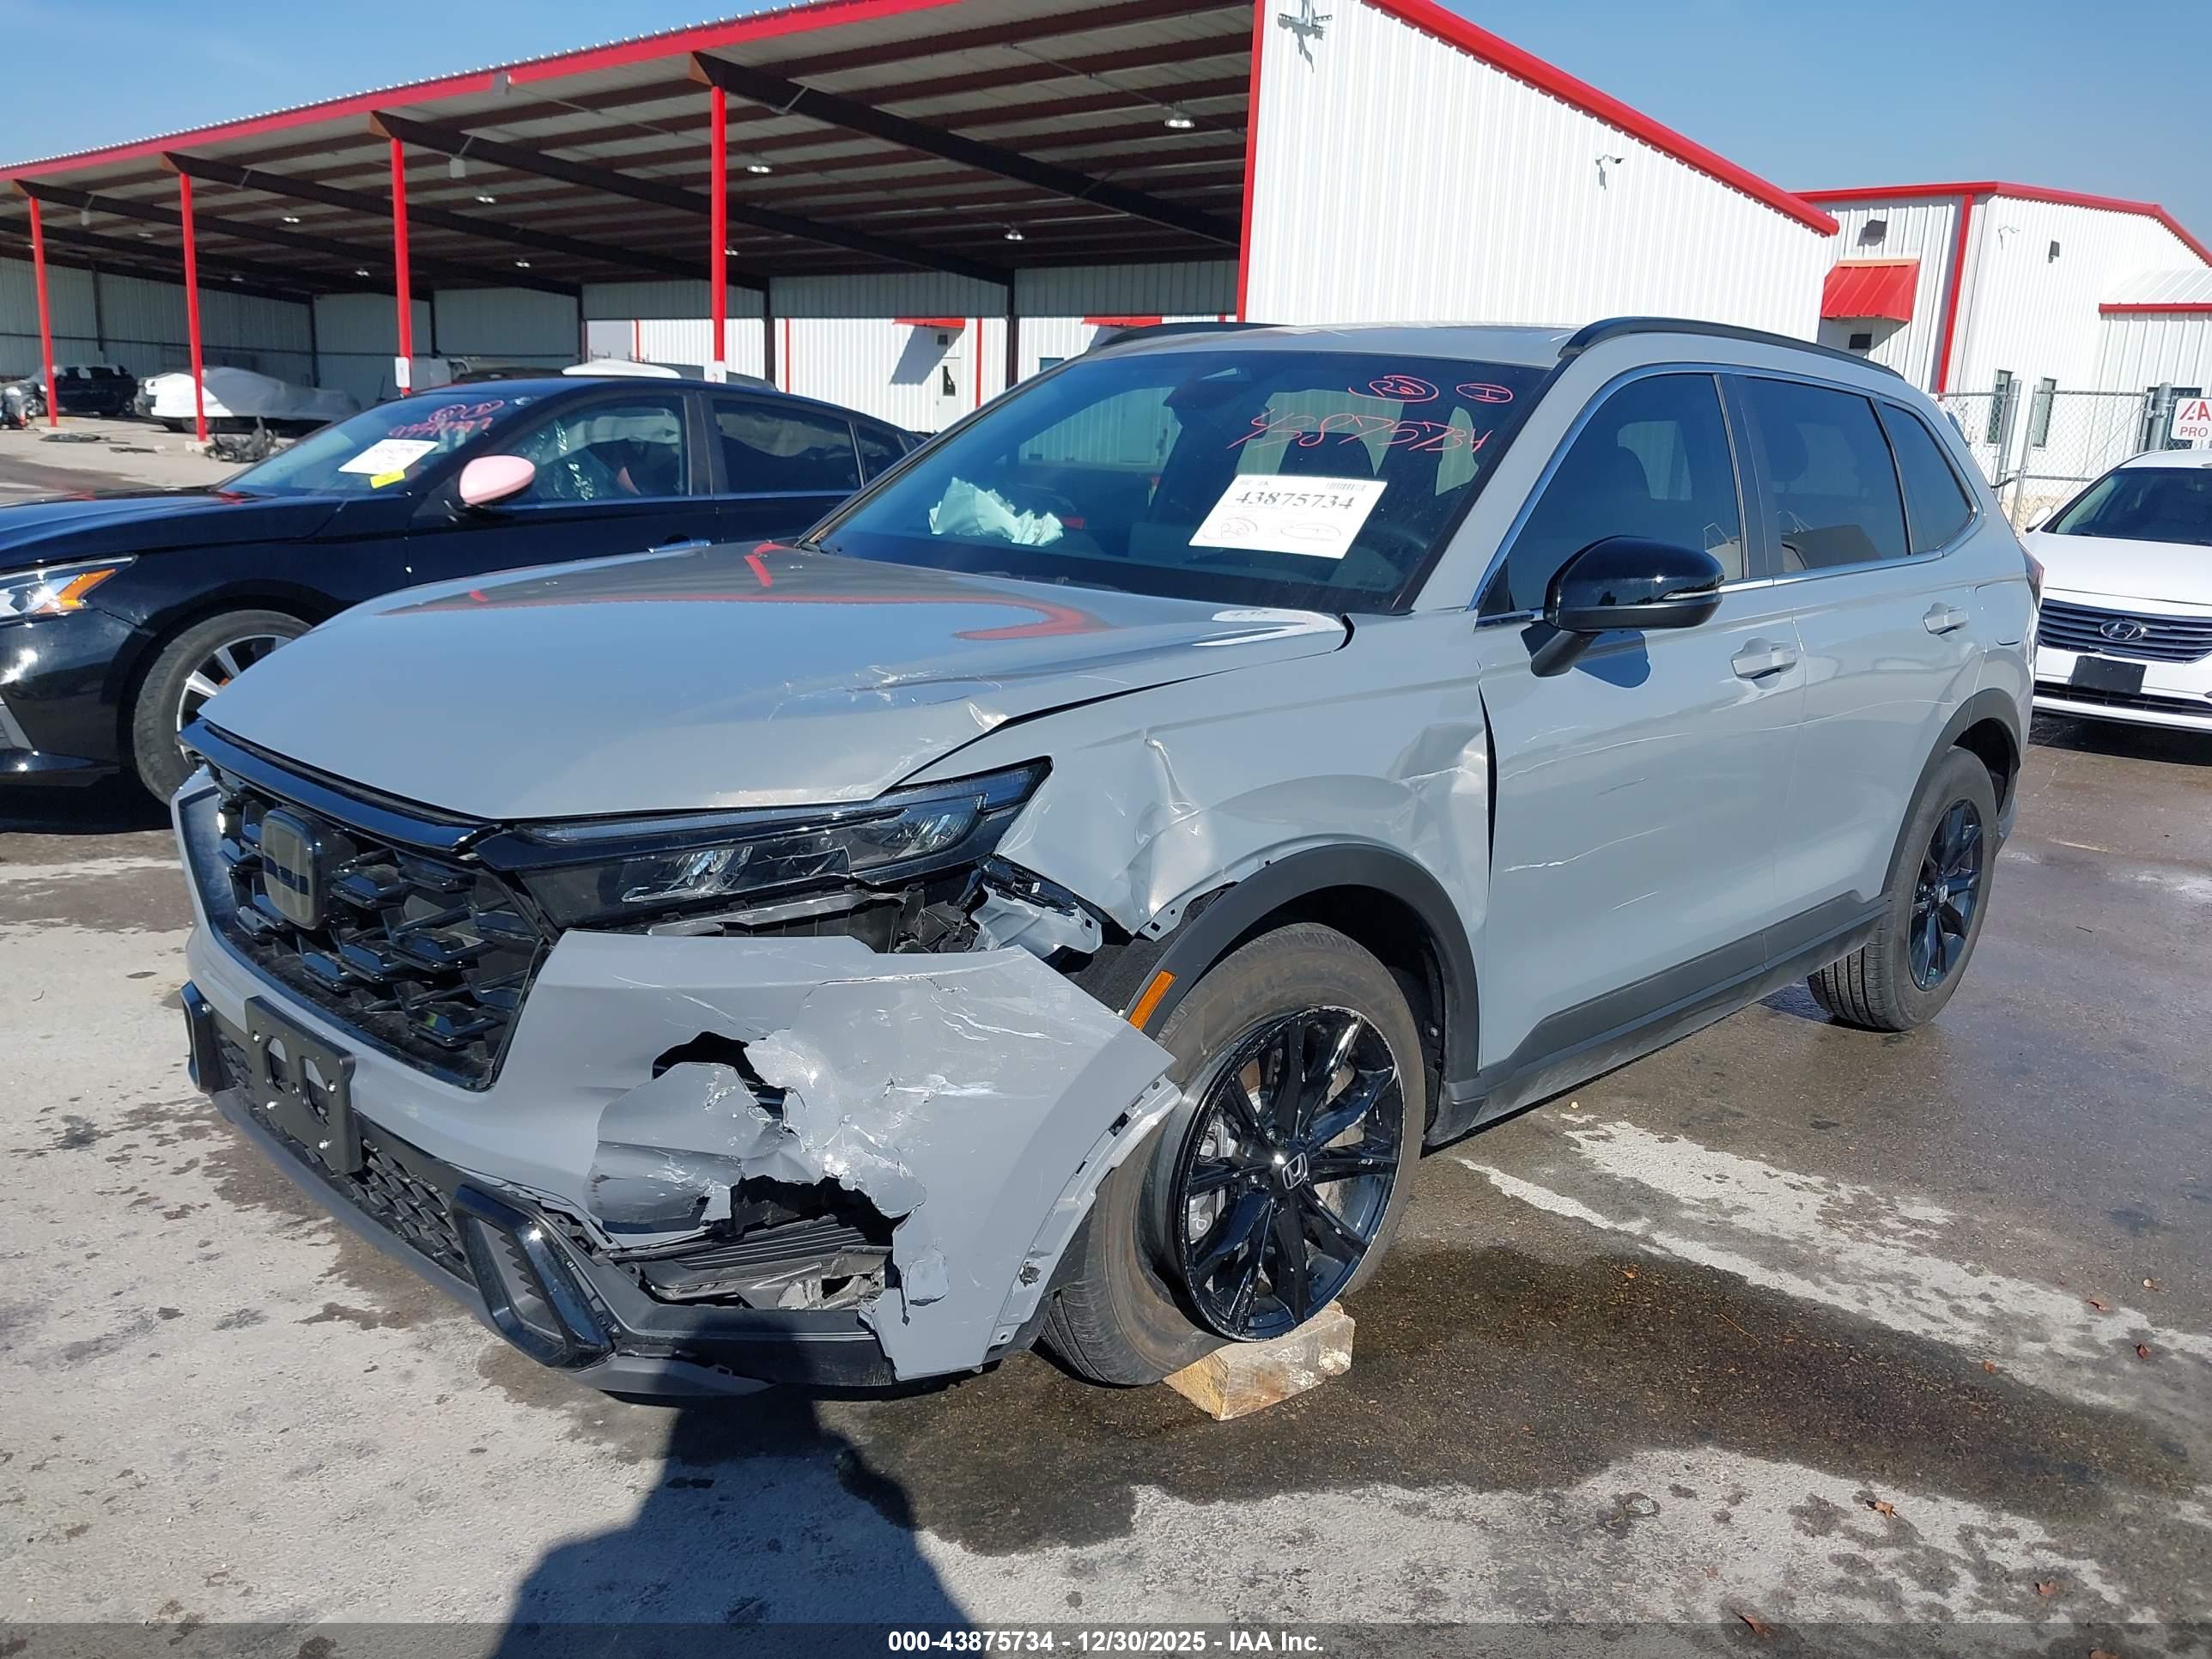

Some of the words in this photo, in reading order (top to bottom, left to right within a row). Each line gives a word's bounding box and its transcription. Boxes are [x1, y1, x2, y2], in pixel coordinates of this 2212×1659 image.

[1226, 408, 1493, 453] 43875734
[2179, 426, 2209, 438] PRO
[1236, 490, 1355, 510] 43875734
